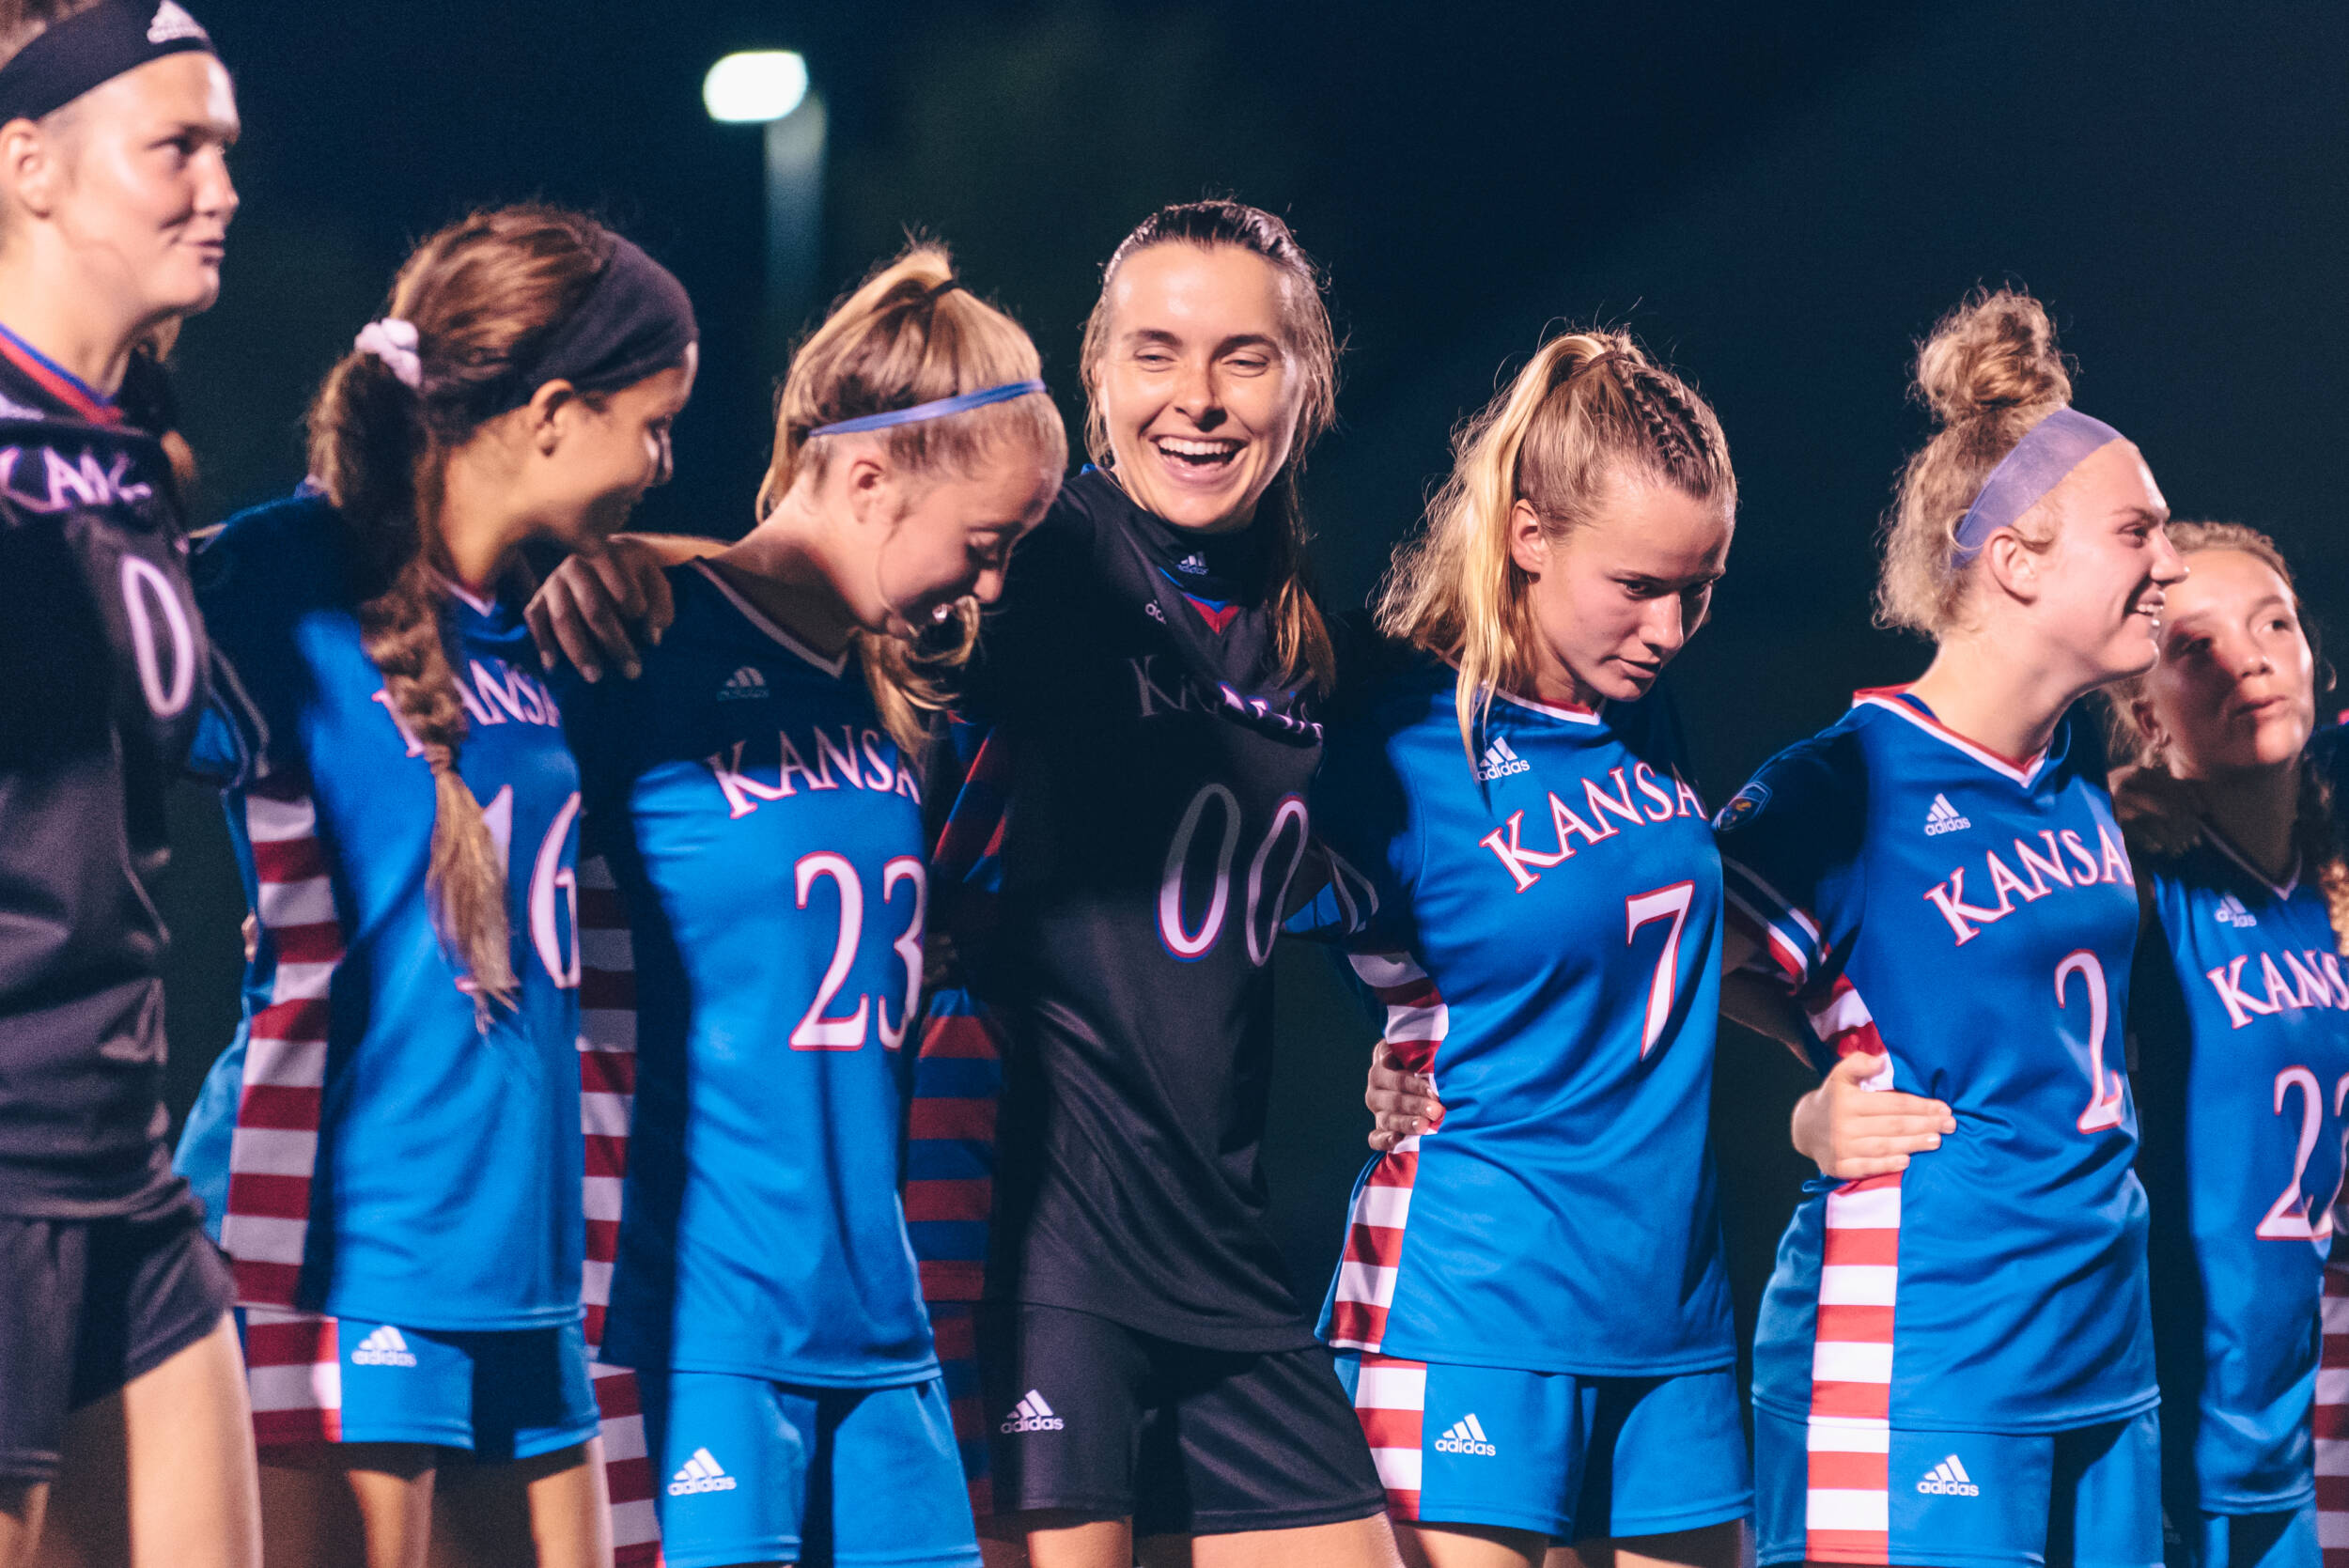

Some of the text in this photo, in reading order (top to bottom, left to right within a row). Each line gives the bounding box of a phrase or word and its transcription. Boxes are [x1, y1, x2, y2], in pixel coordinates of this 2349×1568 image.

[1476, 757, 1531, 782] adidas
[1478, 760, 1709, 894] KANSA
[1924, 815, 1971, 837] adidas
[1155, 784, 1309, 967] 00
[1922, 823, 2136, 948] KANSA
[788, 850, 926, 1051] 23
[1626, 879, 1695, 1063] 7
[2206, 949, 2349, 1030] KANS
[2055, 948, 2123, 1134] 2
[350, 1349, 418, 1368] adidas
[1000, 1416, 1065, 1434] adidas
[1435, 1437, 1496, 1457] adidas
[667, 1476, 737, 1497] adidas
[1917, 1480, 1980, 1497] adidas
